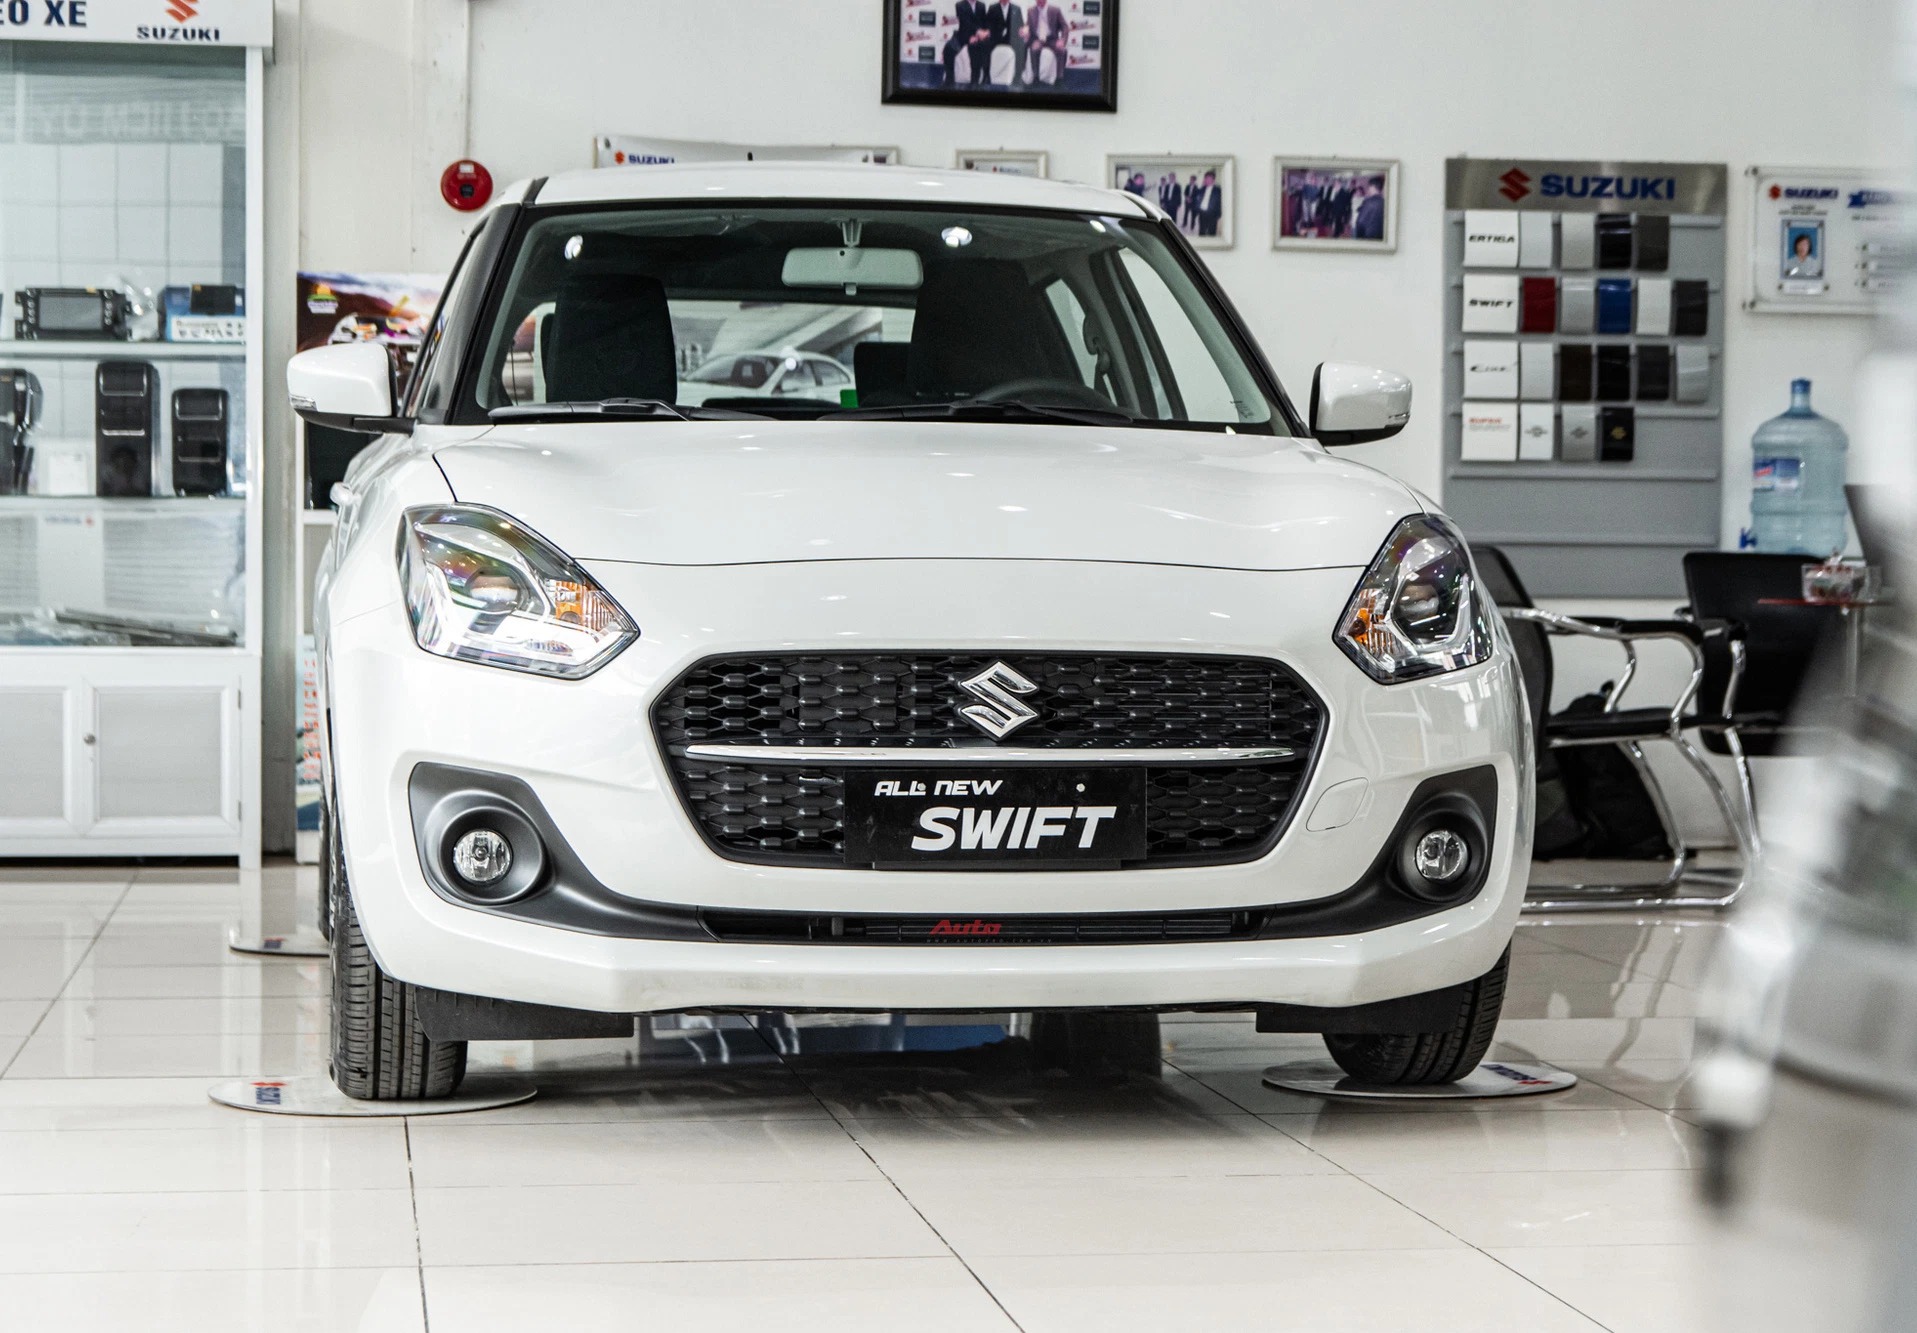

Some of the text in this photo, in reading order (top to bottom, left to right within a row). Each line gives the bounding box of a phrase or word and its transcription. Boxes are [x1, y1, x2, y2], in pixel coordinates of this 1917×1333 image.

[0, 0, 87, 27] O XE
[137, 26, 220, 41] SUZUKI
[1540, 174, 1676, 199] SUZUKI
[1784, 187, 1839, 199] SUZUKI
[934, 780, 1003, 796] NEW
[911, 806, 1117, 851] SWIFT
